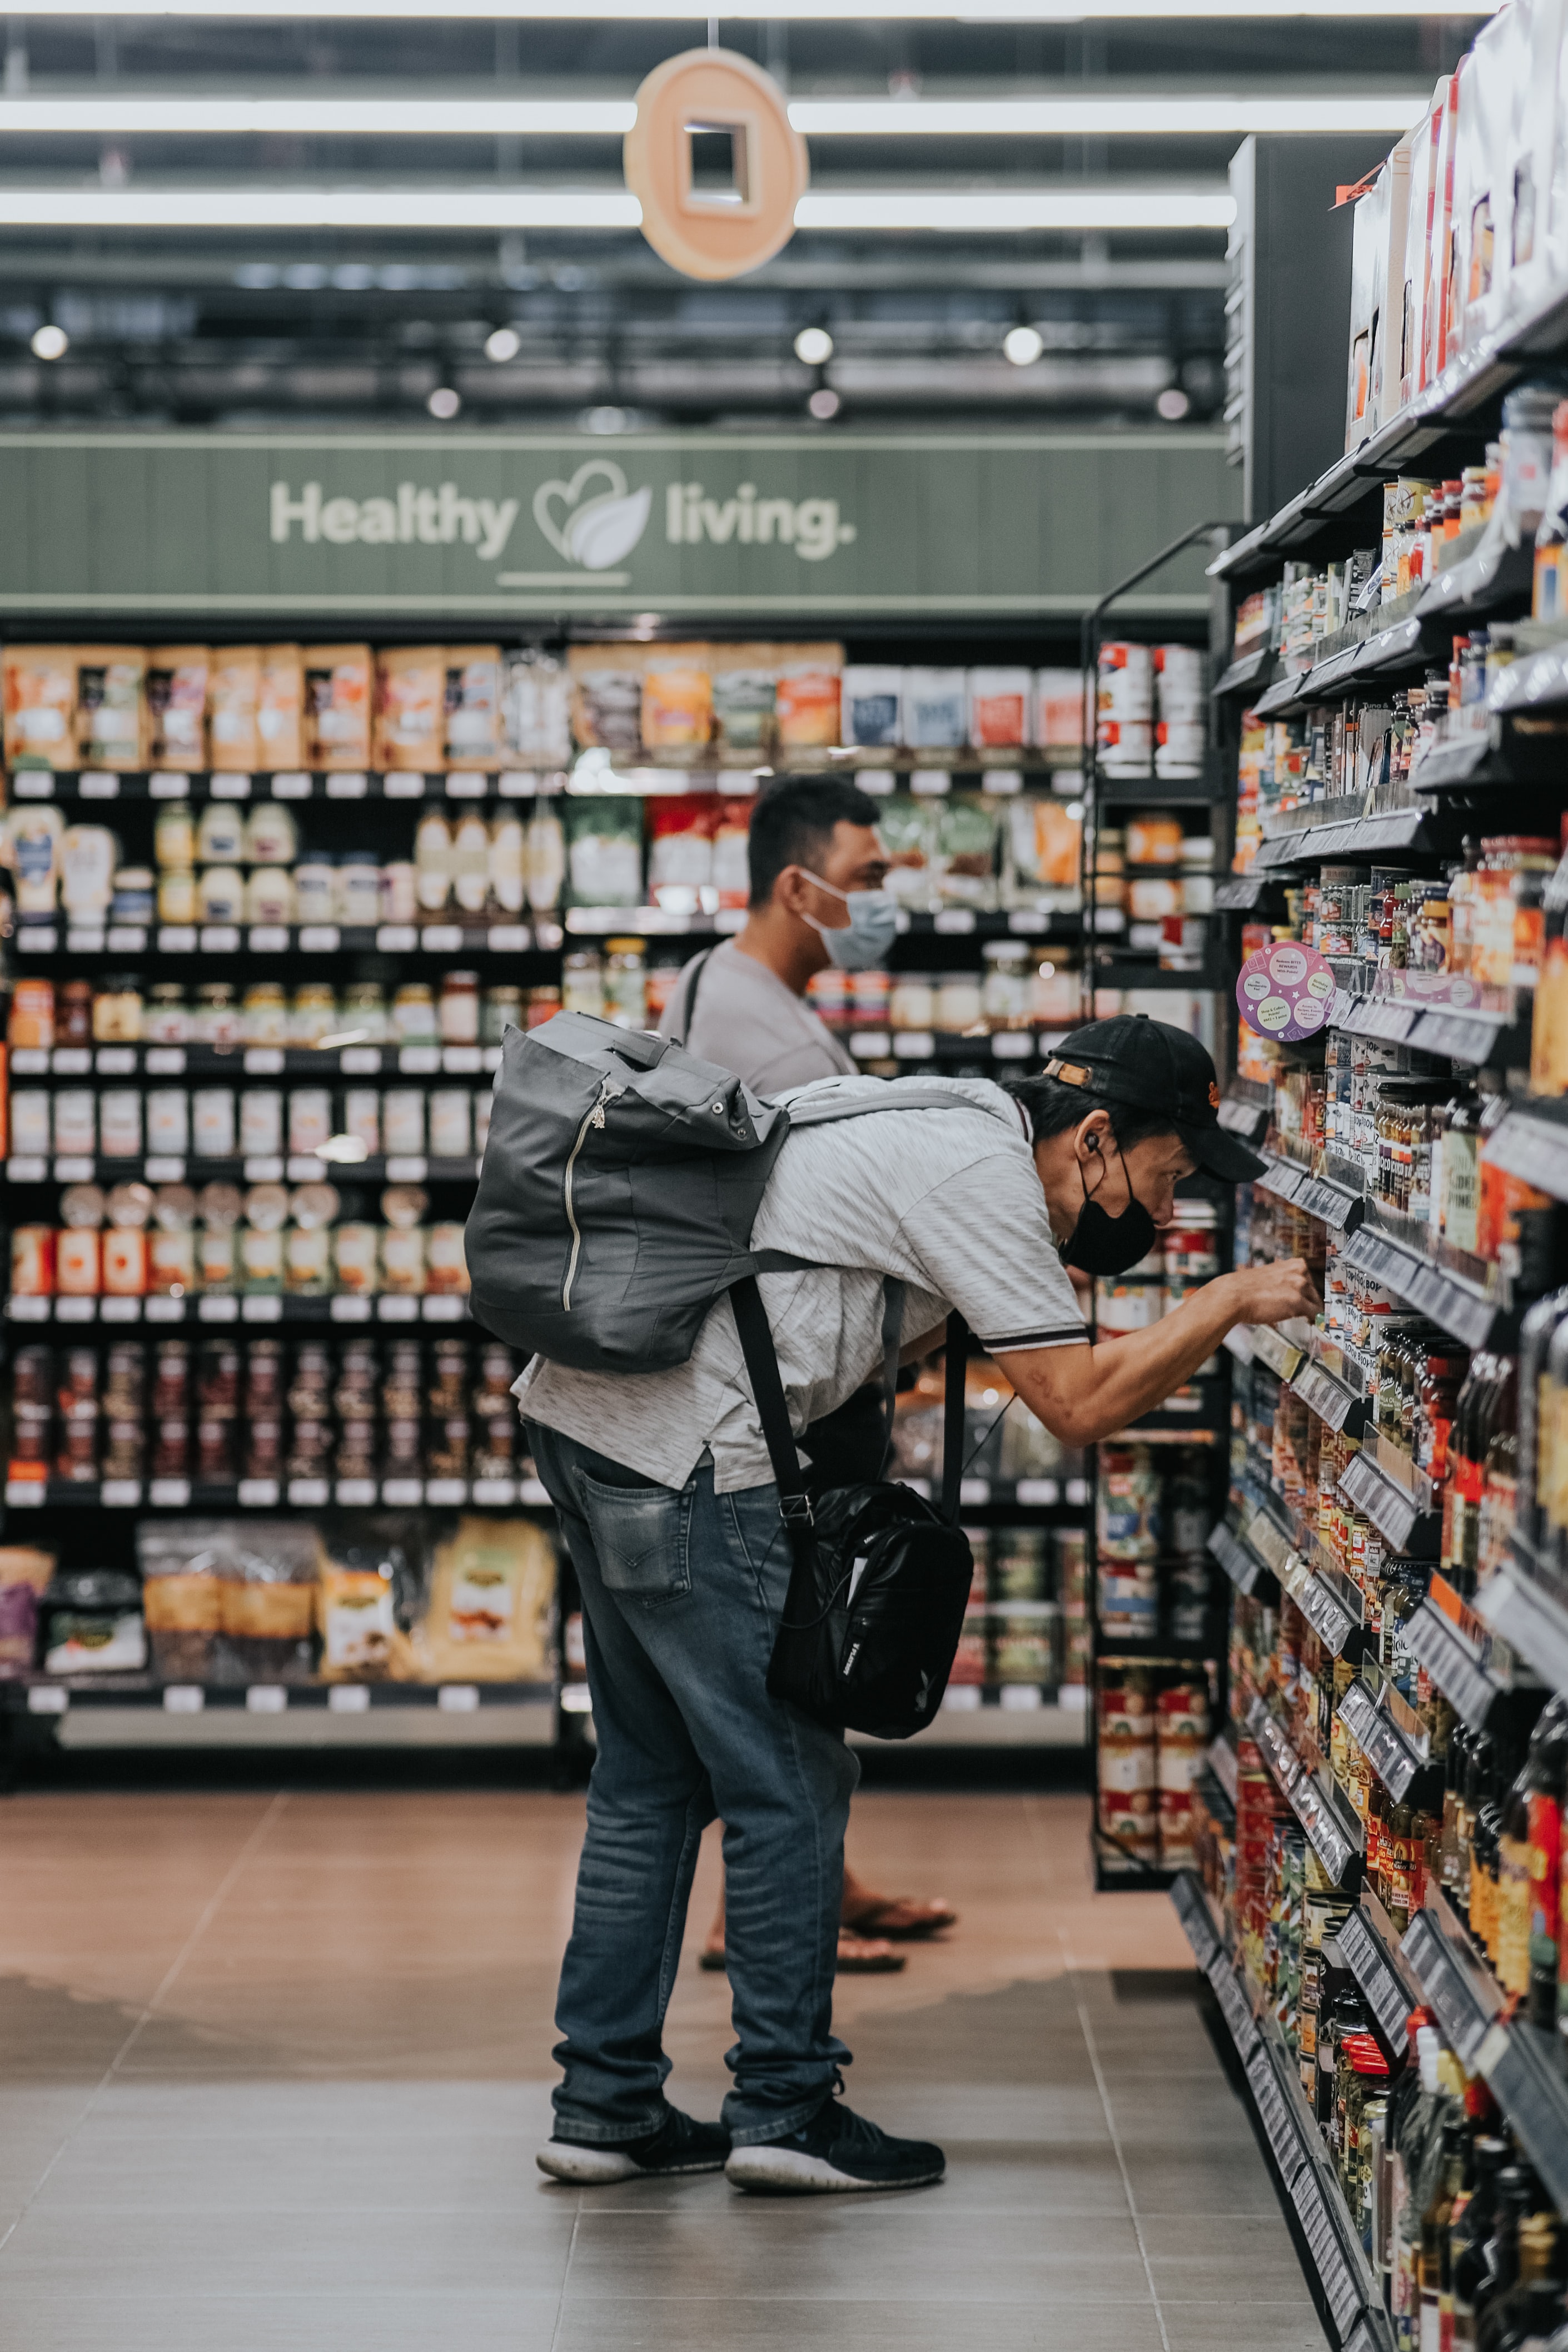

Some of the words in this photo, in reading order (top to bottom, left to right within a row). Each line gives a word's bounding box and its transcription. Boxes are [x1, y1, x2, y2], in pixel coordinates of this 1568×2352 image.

[270, 481, 519, 561] Healthy
[665, 482, 859, 561] living.
[1311, 983, 1326, 992] Rewards
[1313, 979, 1328, 988] Birthday
[1366, 1280, 1382, 1292] BOY
